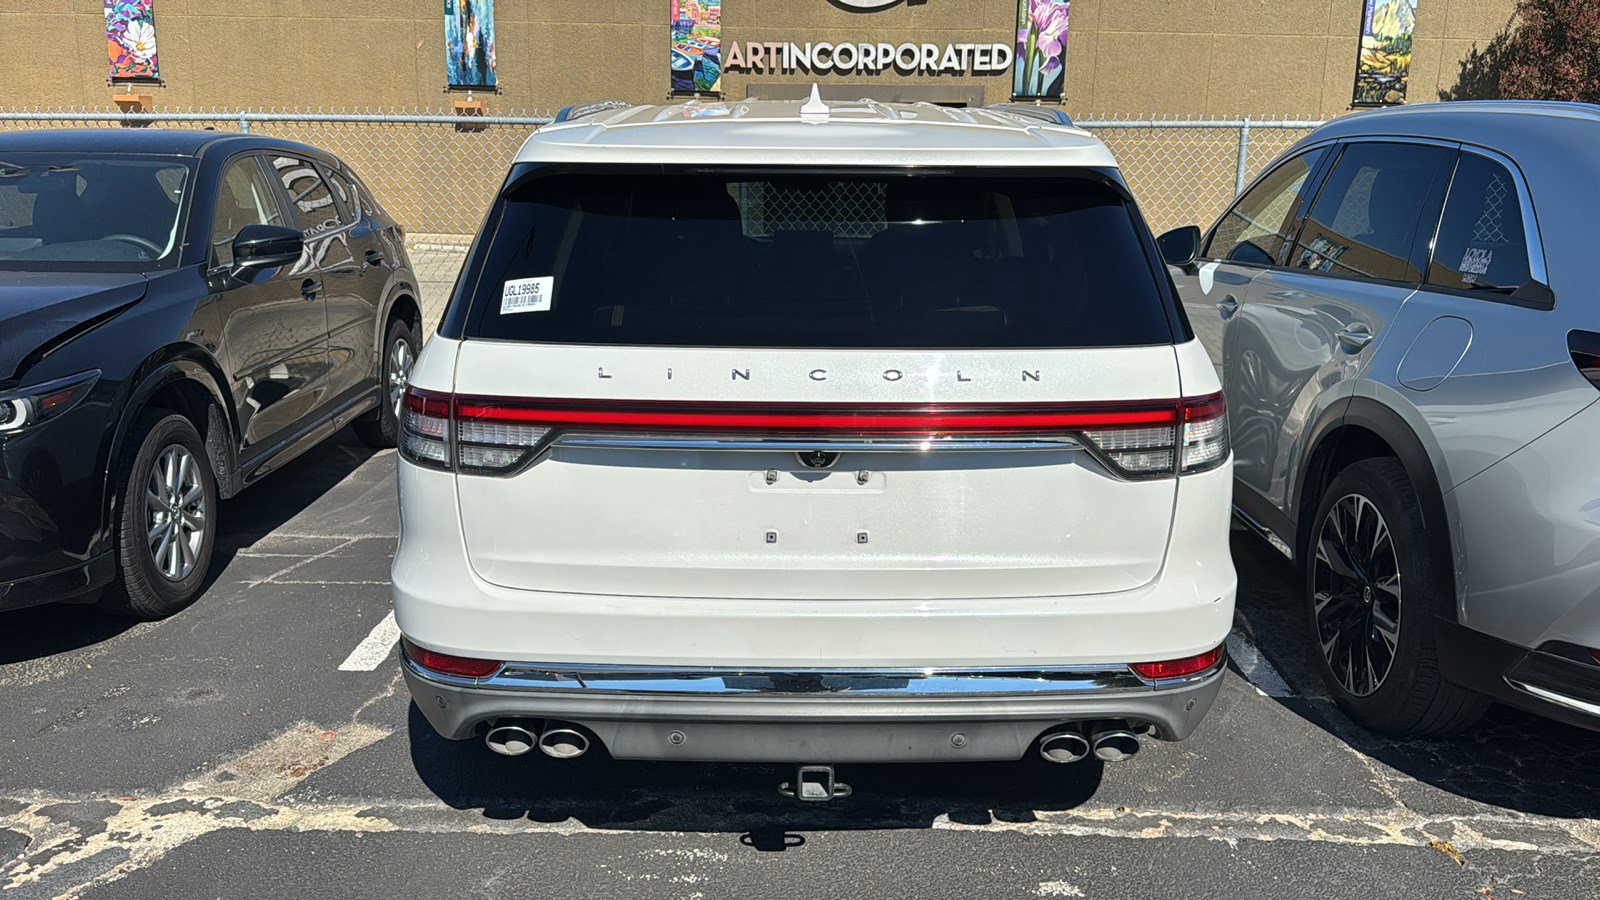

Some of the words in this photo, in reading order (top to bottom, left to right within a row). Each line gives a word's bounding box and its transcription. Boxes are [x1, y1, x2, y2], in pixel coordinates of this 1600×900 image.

[724, 41, 1013, 71] ARTINCORPORATED
[504, 282, 540, 297] UGL19985
[598, 366, 1040, 382] LINCOLN
